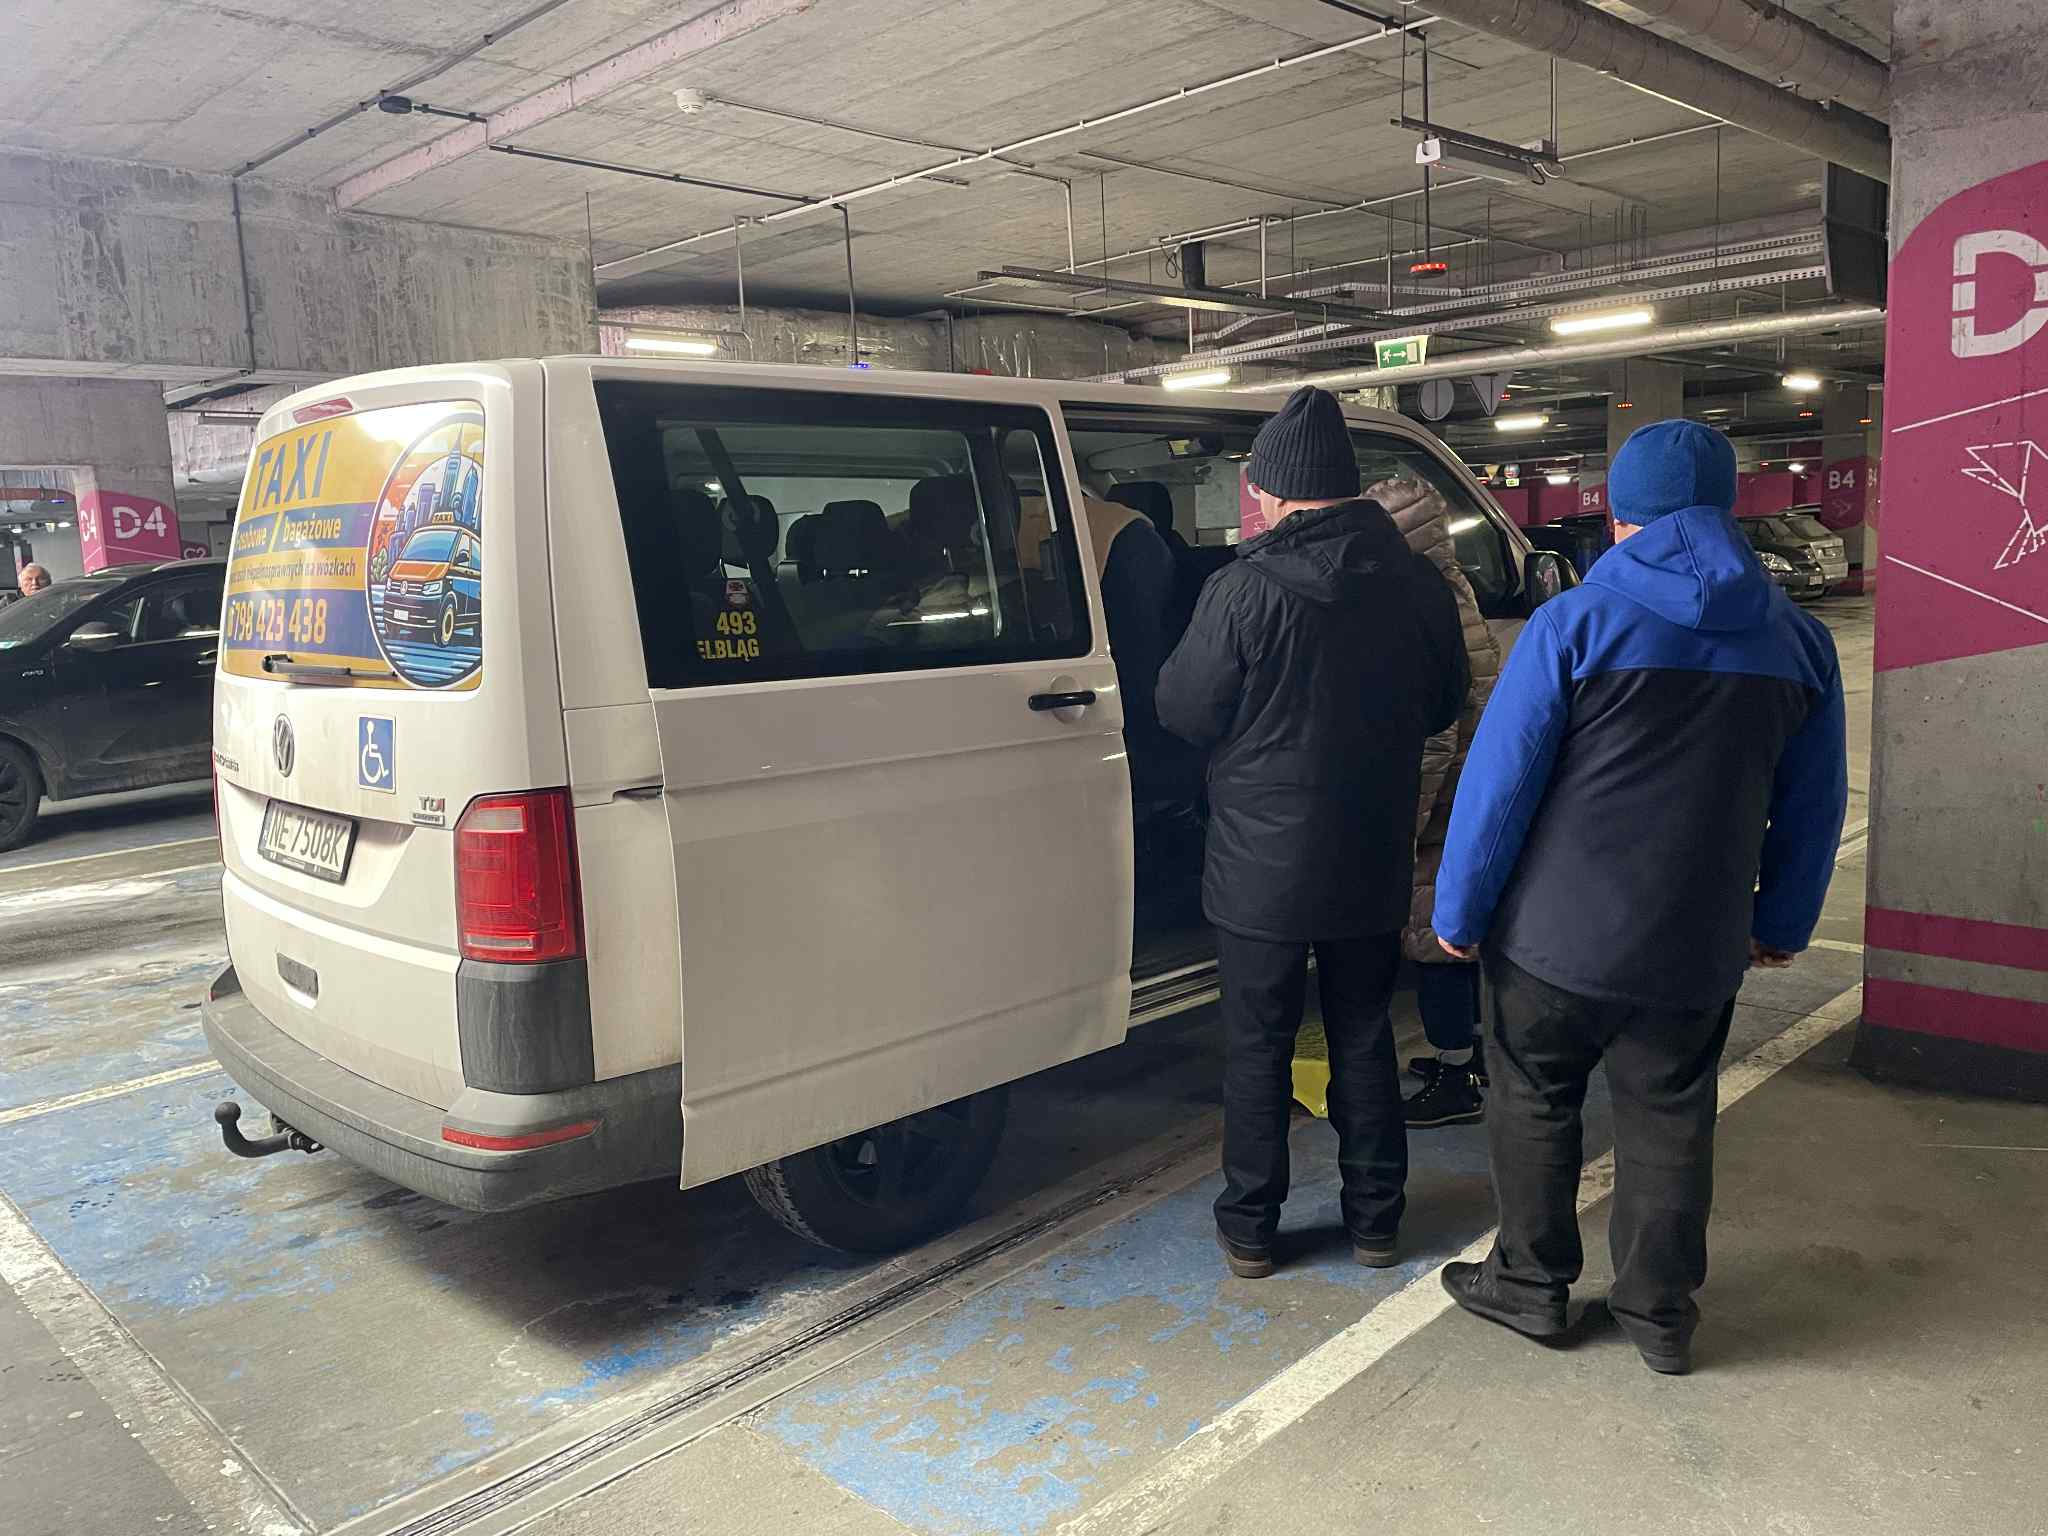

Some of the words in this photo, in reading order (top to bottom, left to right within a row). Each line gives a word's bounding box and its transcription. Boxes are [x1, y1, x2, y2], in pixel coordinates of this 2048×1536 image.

[253, 431, 332, 511] TAXI
[1829, 470, 1856, 489] B4
[1583, 491, 1600, 506] B4
[80, 508, 98, 542] D4
[112, 506, 167, 539] D4
[283, 512, 341, 548] bagażowe
[316, 556, 356, 577] wózkach
[233, 600, 253, 641] 798
[256, 598, 285, 642] 423
[288, 598, 327, 644] 438
[717, 611, 757, 635] 493
[697, 639, 760, 662] ELBLĄG
[269, 804, 293, 850] NE
[290, 815, 347, 867] 7508K
